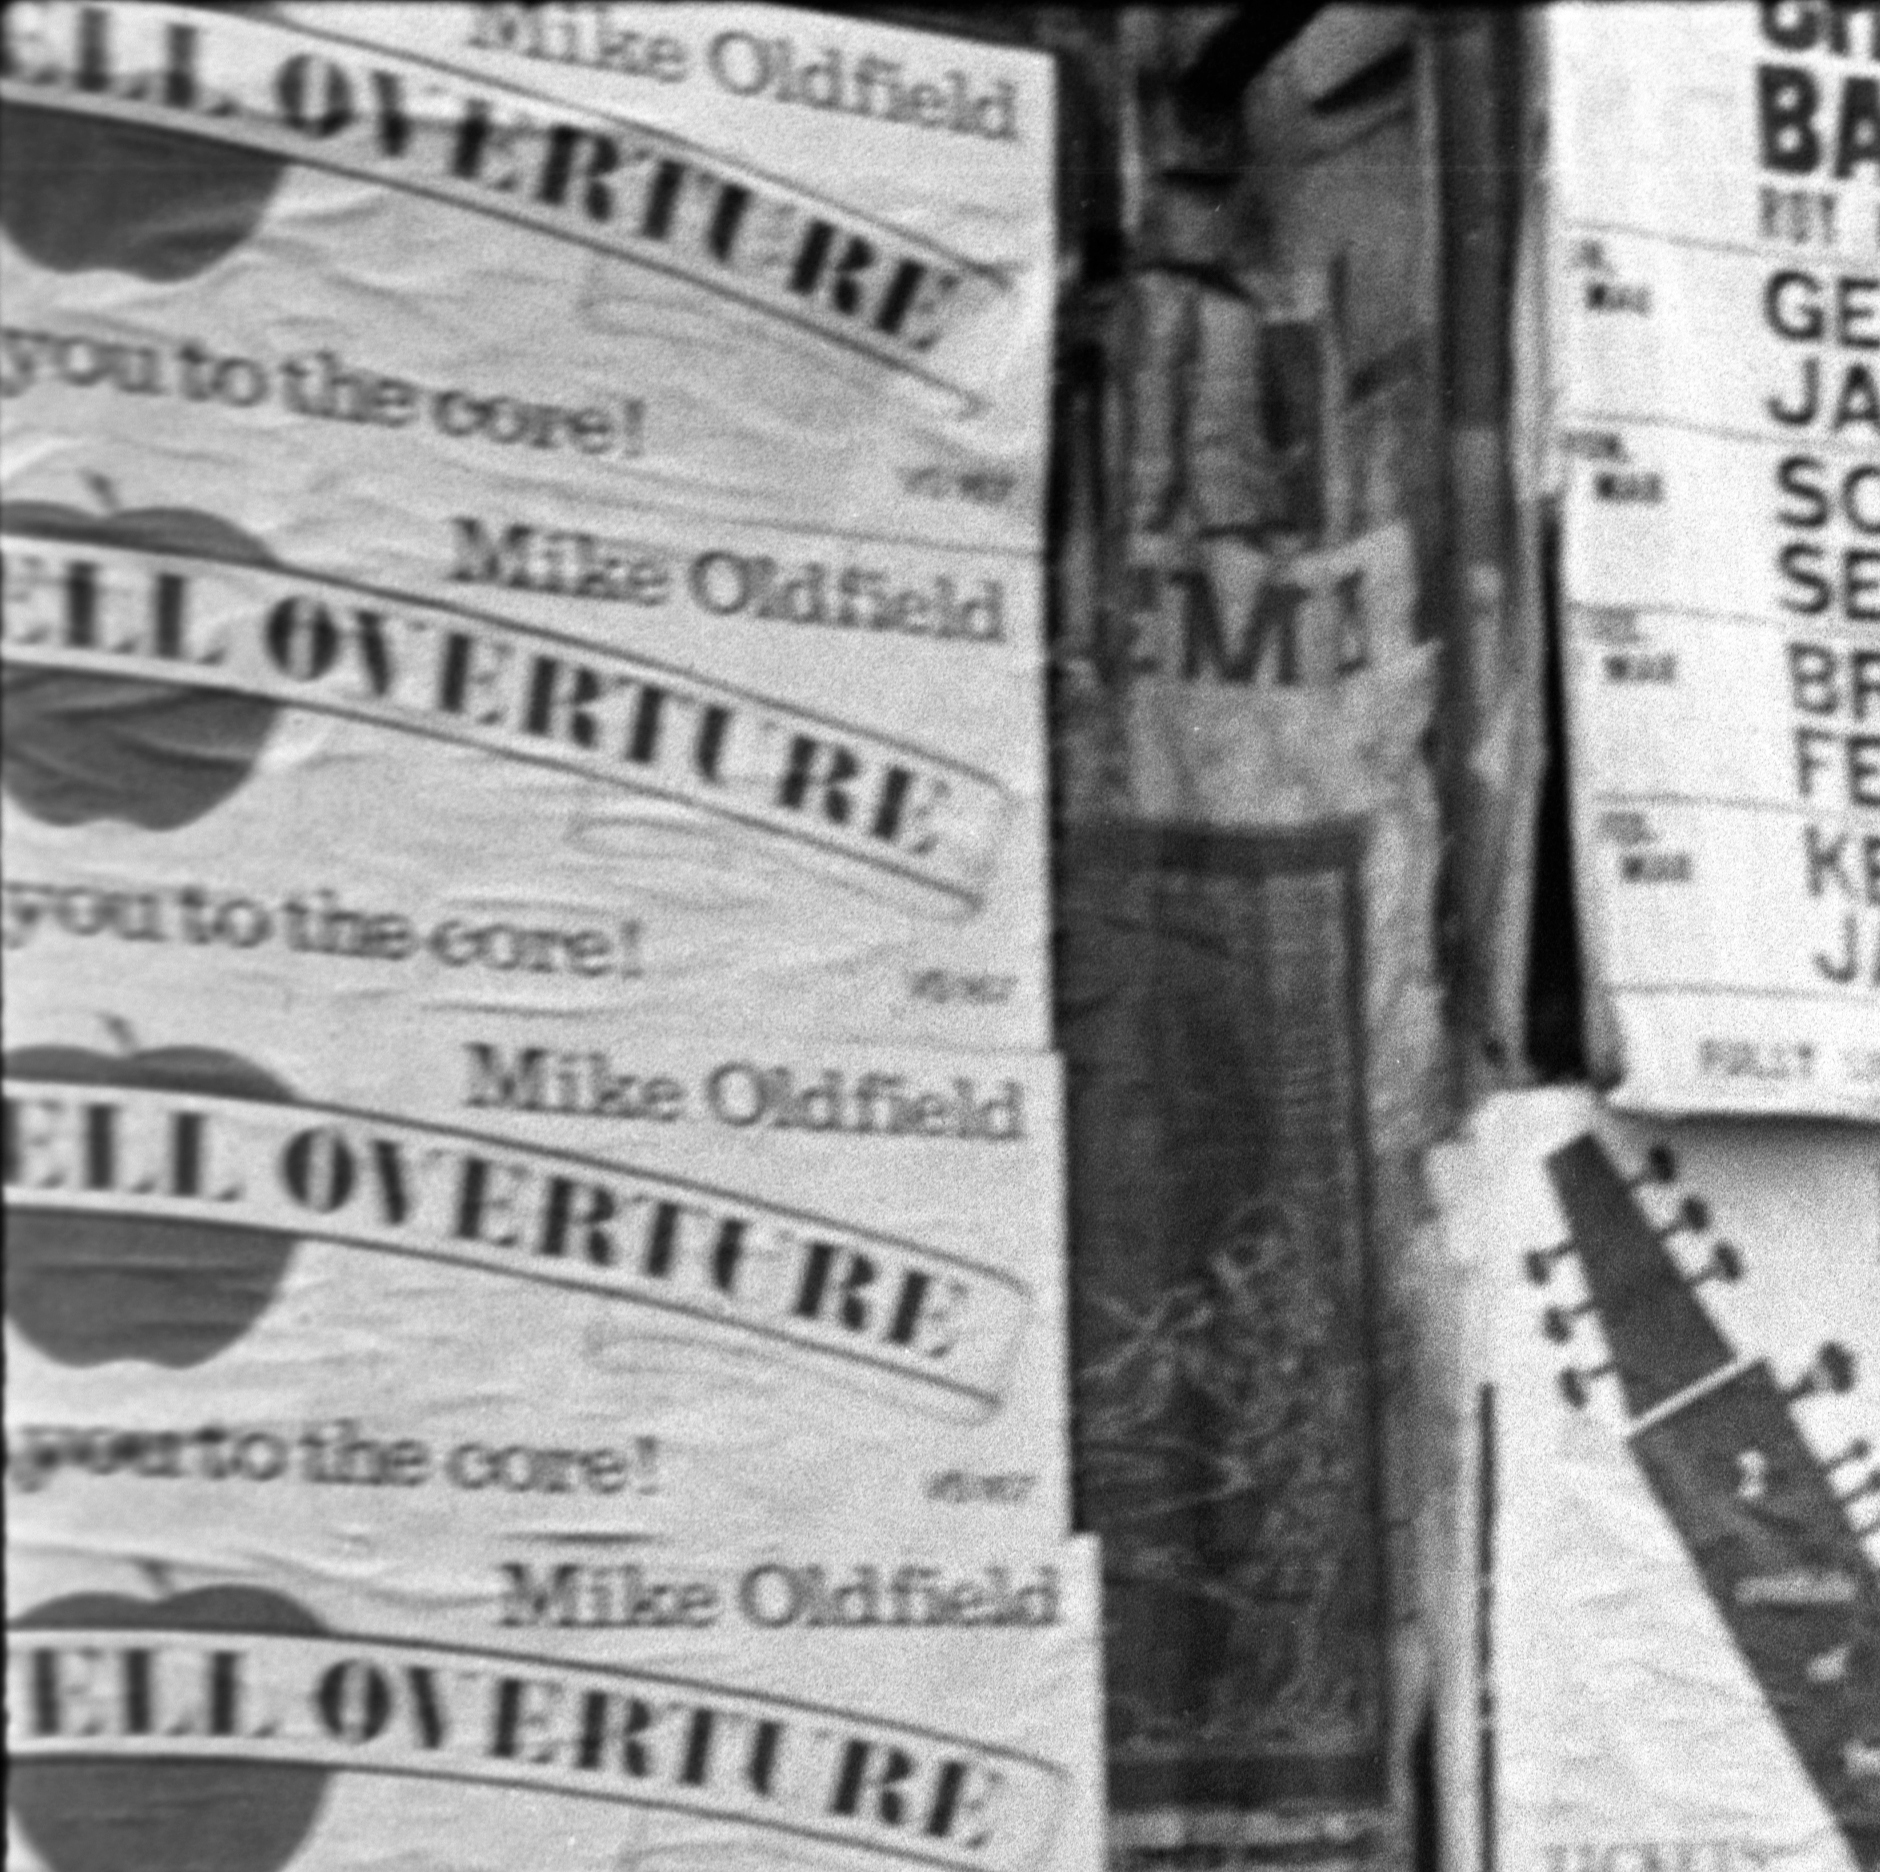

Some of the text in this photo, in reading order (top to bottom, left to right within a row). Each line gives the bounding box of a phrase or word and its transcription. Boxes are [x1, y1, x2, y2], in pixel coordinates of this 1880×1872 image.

[467, 0, 1021, 144] Mike Oldfield
[274, 49, 961, 352] OVERTURE
[178, 341, 268, 408] to
[280, 350, 415, 426] the
[433, 386, 647, 460] core!
[447, 517, 1006, 645] Mike Oldfield
[266, 592, 955, 856] OVERTURE
[2, 884, 647, 980] you to the core!
[463, 1041, 1027, 1144] Mike Oldfield
[0, 1095, 972, 1359] ELL OVERTURE
[9, 1418, 665, 1497] you to the core!
[499, 1564, 1064, 1629] Mike Oldfield
[30, 1647, 1004, 1851] ELL OVERTURE
